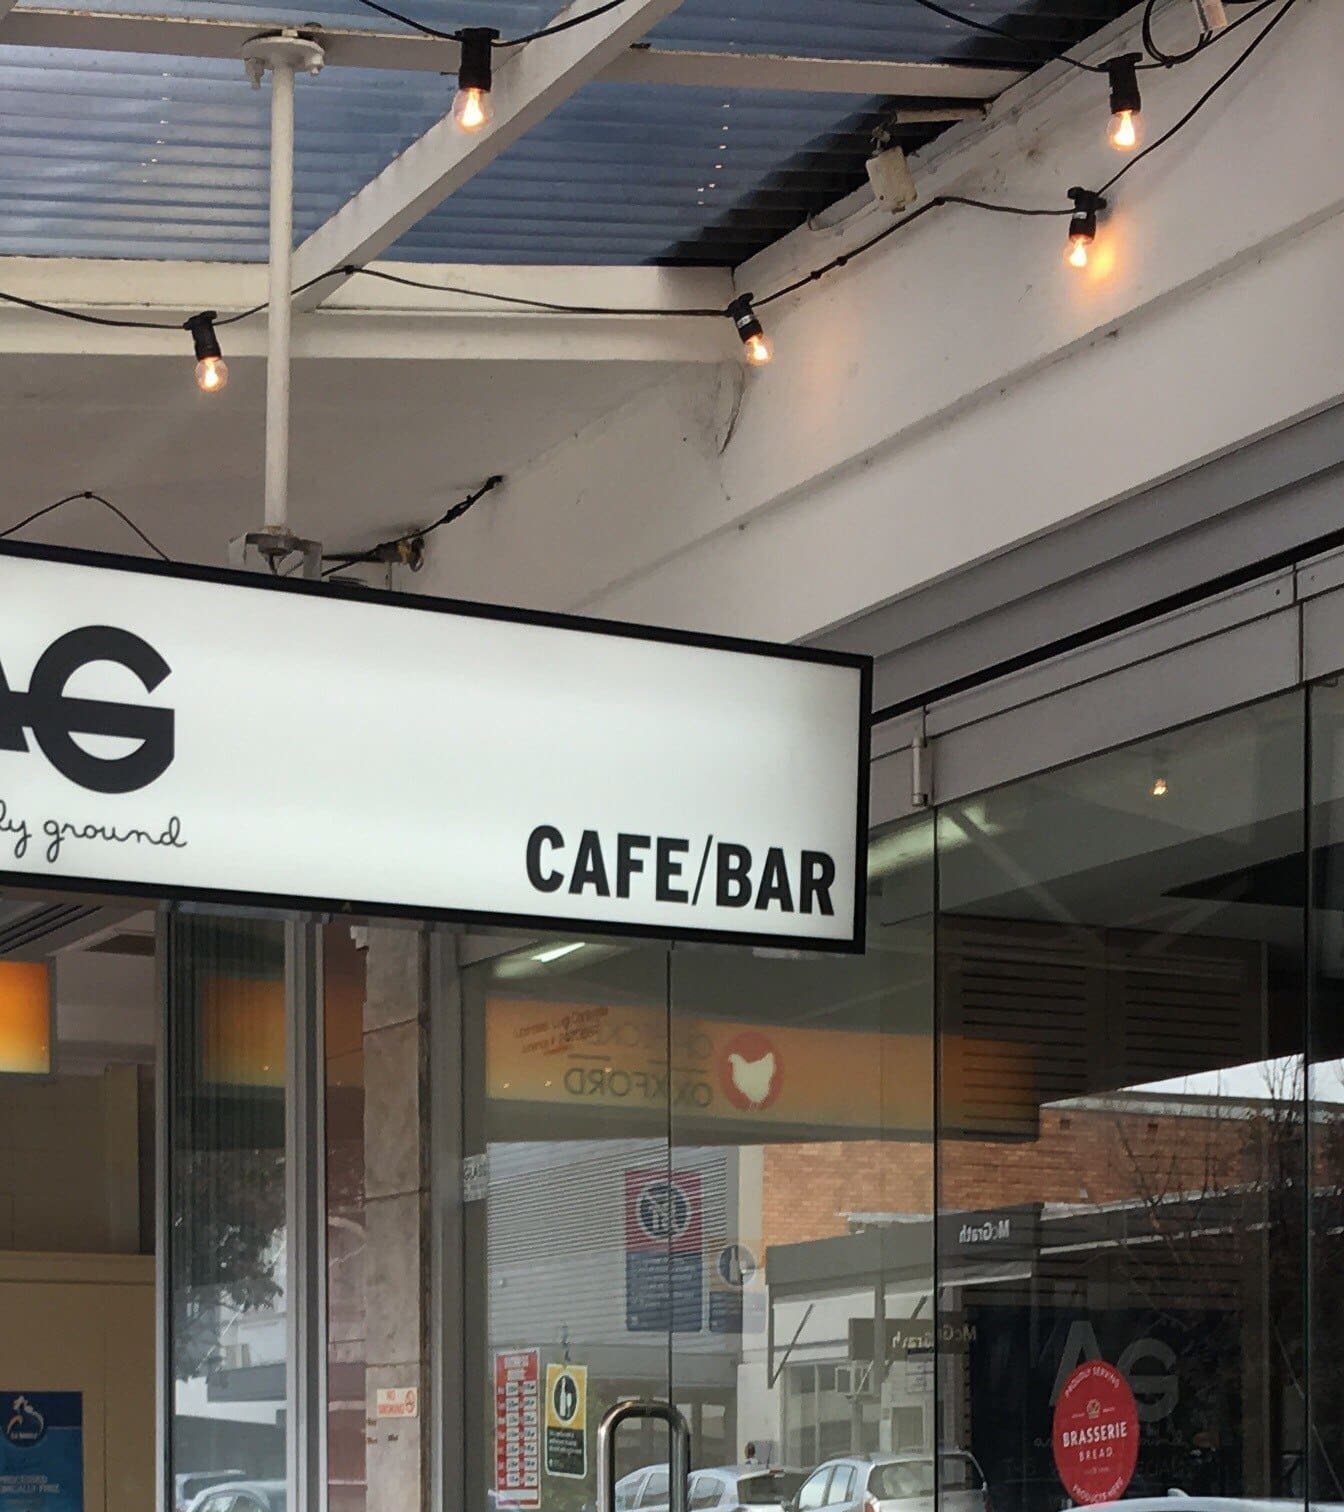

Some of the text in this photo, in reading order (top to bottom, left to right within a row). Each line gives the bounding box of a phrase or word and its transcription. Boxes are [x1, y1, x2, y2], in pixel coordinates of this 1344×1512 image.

[43, 815, 188, 863] ground
[525, 824, 836, 916] CAFE/BAR
[1062, 1421, 1127, 1447] BRASSERIE
[1079, 1446, 1113, 1463] BREAD
